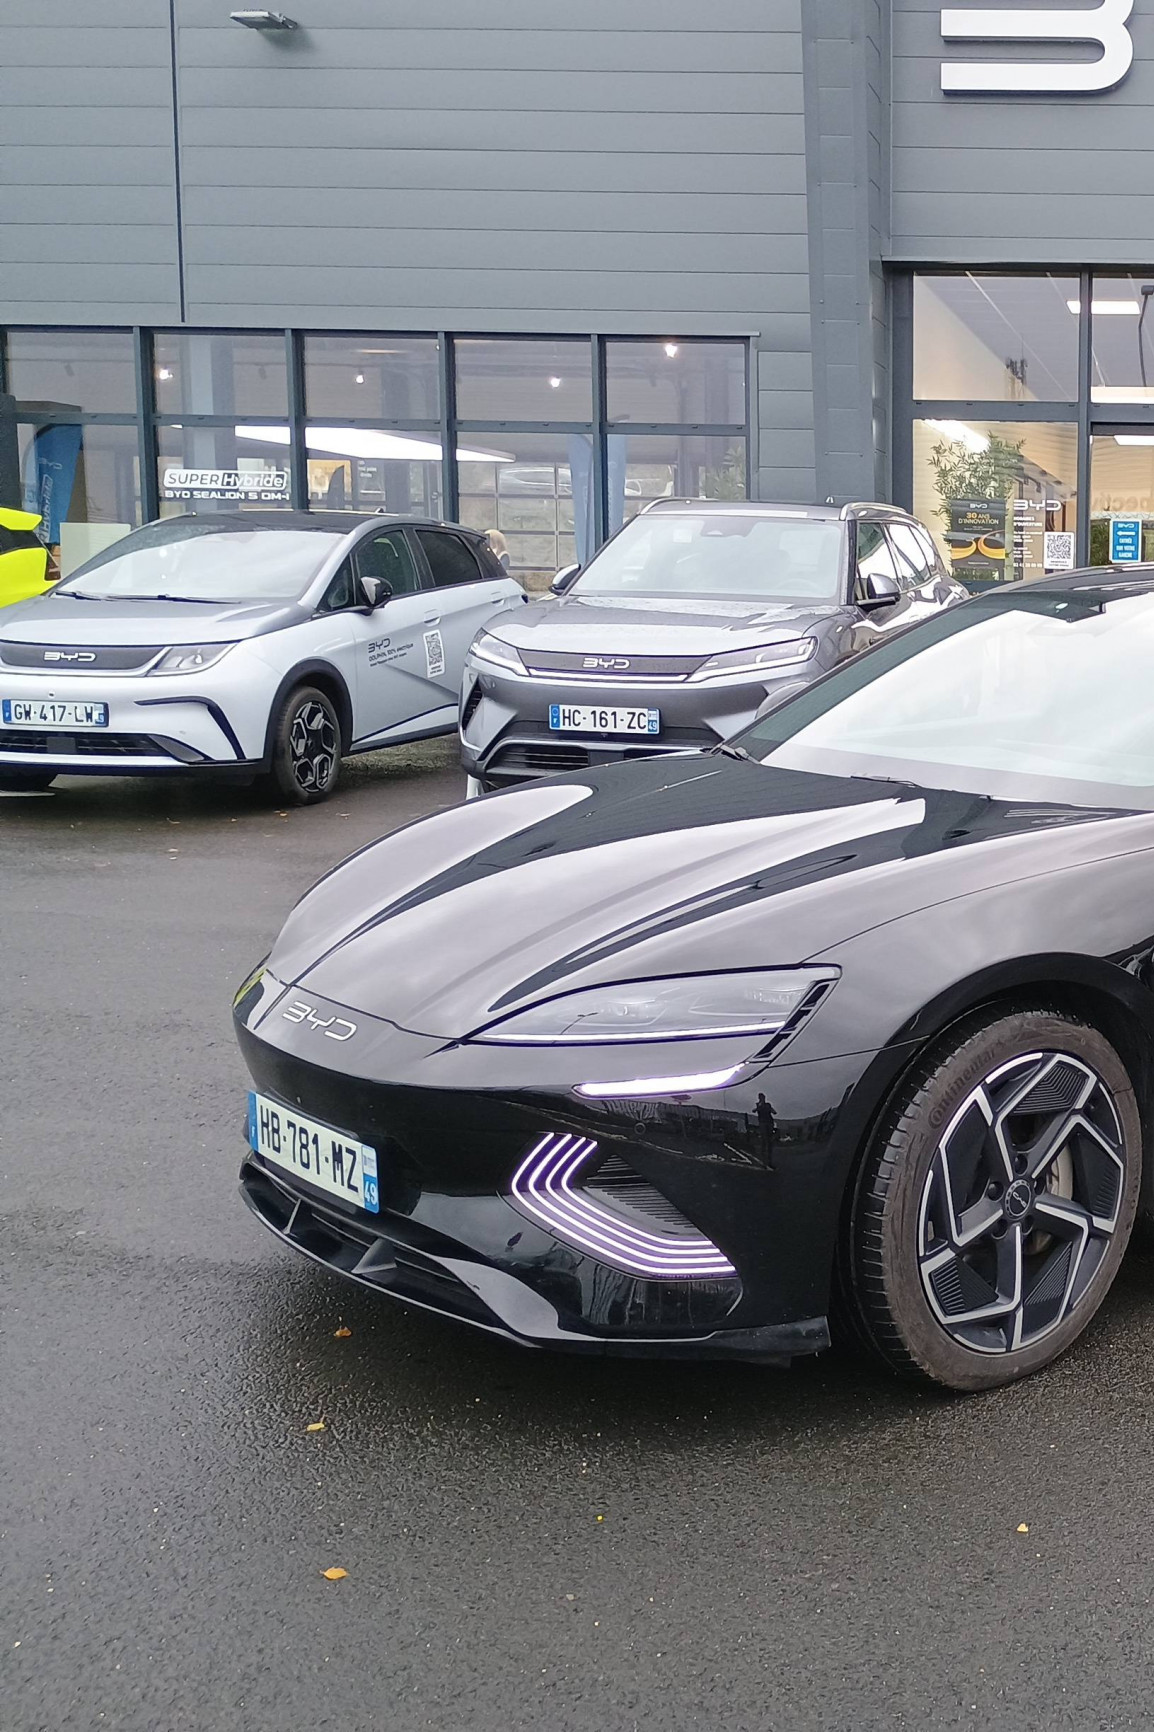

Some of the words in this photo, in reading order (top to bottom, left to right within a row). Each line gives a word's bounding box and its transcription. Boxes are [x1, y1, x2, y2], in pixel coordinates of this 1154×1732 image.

[168, 473, 219, 486] SUPER
[222, 473, 283, 487] Hybride
[165, 491, 191, 499] BYD
[193, 491, 245, 500] SEALION
[248, 492, 258, 500] 5
[1013, 499, 1062, 511] BYD
[368, 638, 391, 654] BYD
[44, 651, 96, 662] BYD
[582, 657, 630, 669] BYD
[14, 703, 93, 723] GW-417-LW
[562, 708, 647, 730] HC-161-ZC
[282, 1001, 358, 1042] BYD
[260, 1104, 359, 1193] HB-781-MZ
[364, 1180, 378, 1203] 49
